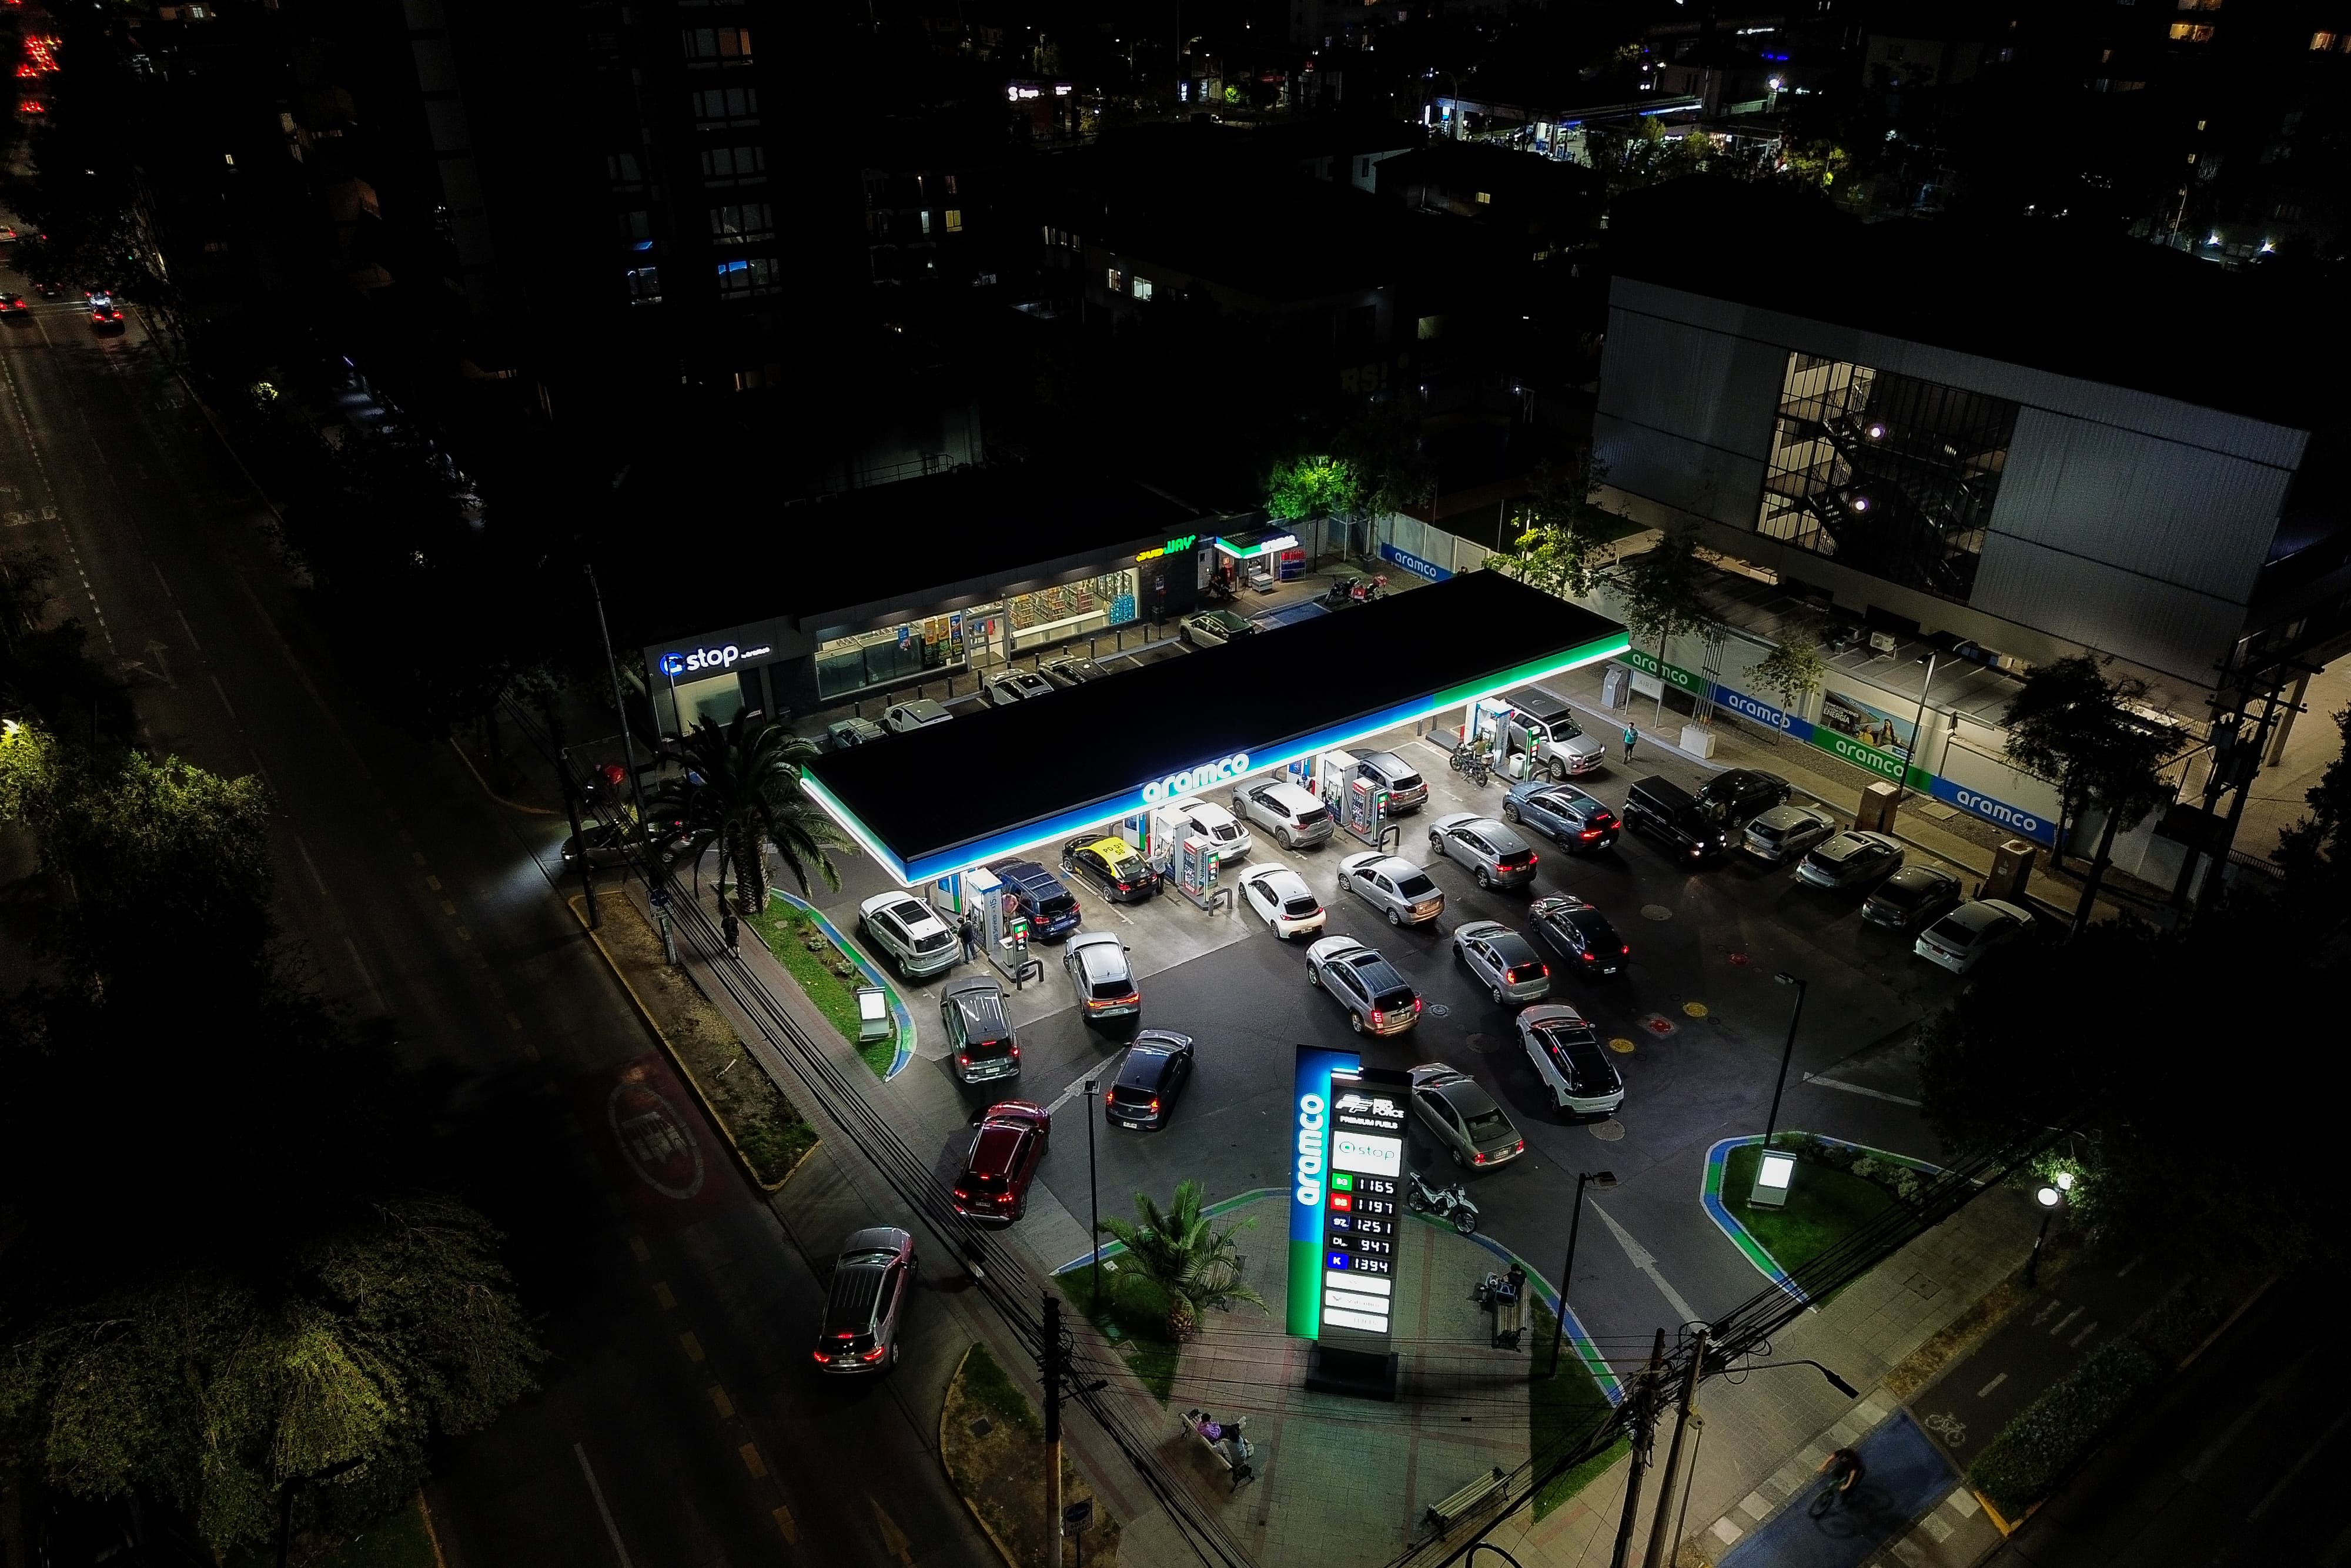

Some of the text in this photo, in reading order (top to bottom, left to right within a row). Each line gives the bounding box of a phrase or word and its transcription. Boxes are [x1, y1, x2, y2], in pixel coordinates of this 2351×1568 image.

[1395, 552, 1436, 577] aramco
[687, 646, 738, 671] stop
[1638, 680, 1654, 689] AIRE
[1728, 695, 1790, 728] aramco
[1823, 708, 1850, 724] ENERGÍA
[1836, 740, 1904, 777] aramco
[1142, 753, 1250, 804] aramco
[1957, 791, 2036, 831] aramco
[1297, 1094, 1325, 1206] aramco
[1360, 1179, 1394, 1194] 1165
[1359, 1199, 1393, 1214] 1197
[1357, 1219, 1391, 1234] 1251
[1361, 1239, 1389, 1253] 947
[1333, 1256, 1388, 1273] K 1394
